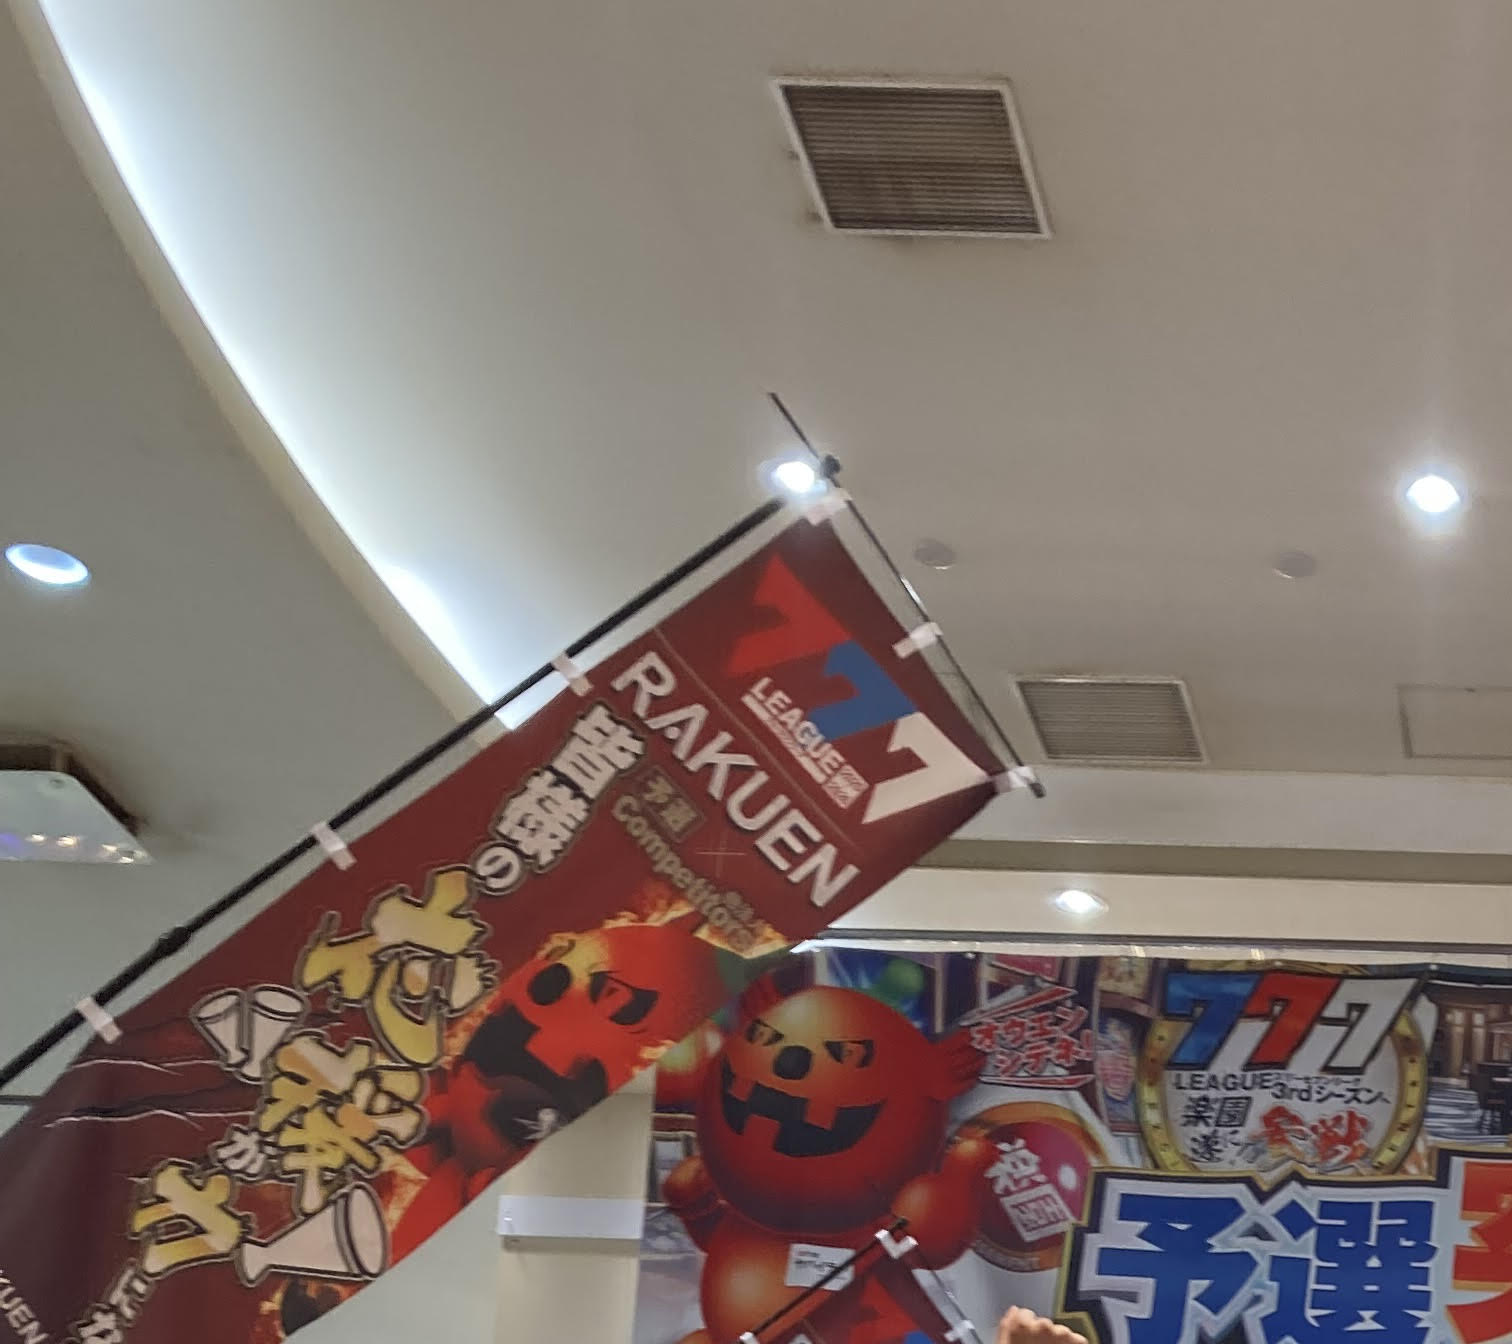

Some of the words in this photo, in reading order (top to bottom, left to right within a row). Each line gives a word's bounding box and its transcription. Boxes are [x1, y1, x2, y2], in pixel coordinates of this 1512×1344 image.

[746, 676, 842, 776] LEAGUE
[612, 650, 860, 908] RAKUEN
[1165, 970, 1421, 1074] 777
[1173, 1072, 1272, 1092] LEAGUE
[1181, 1094, 1253, 1128] 楽園
